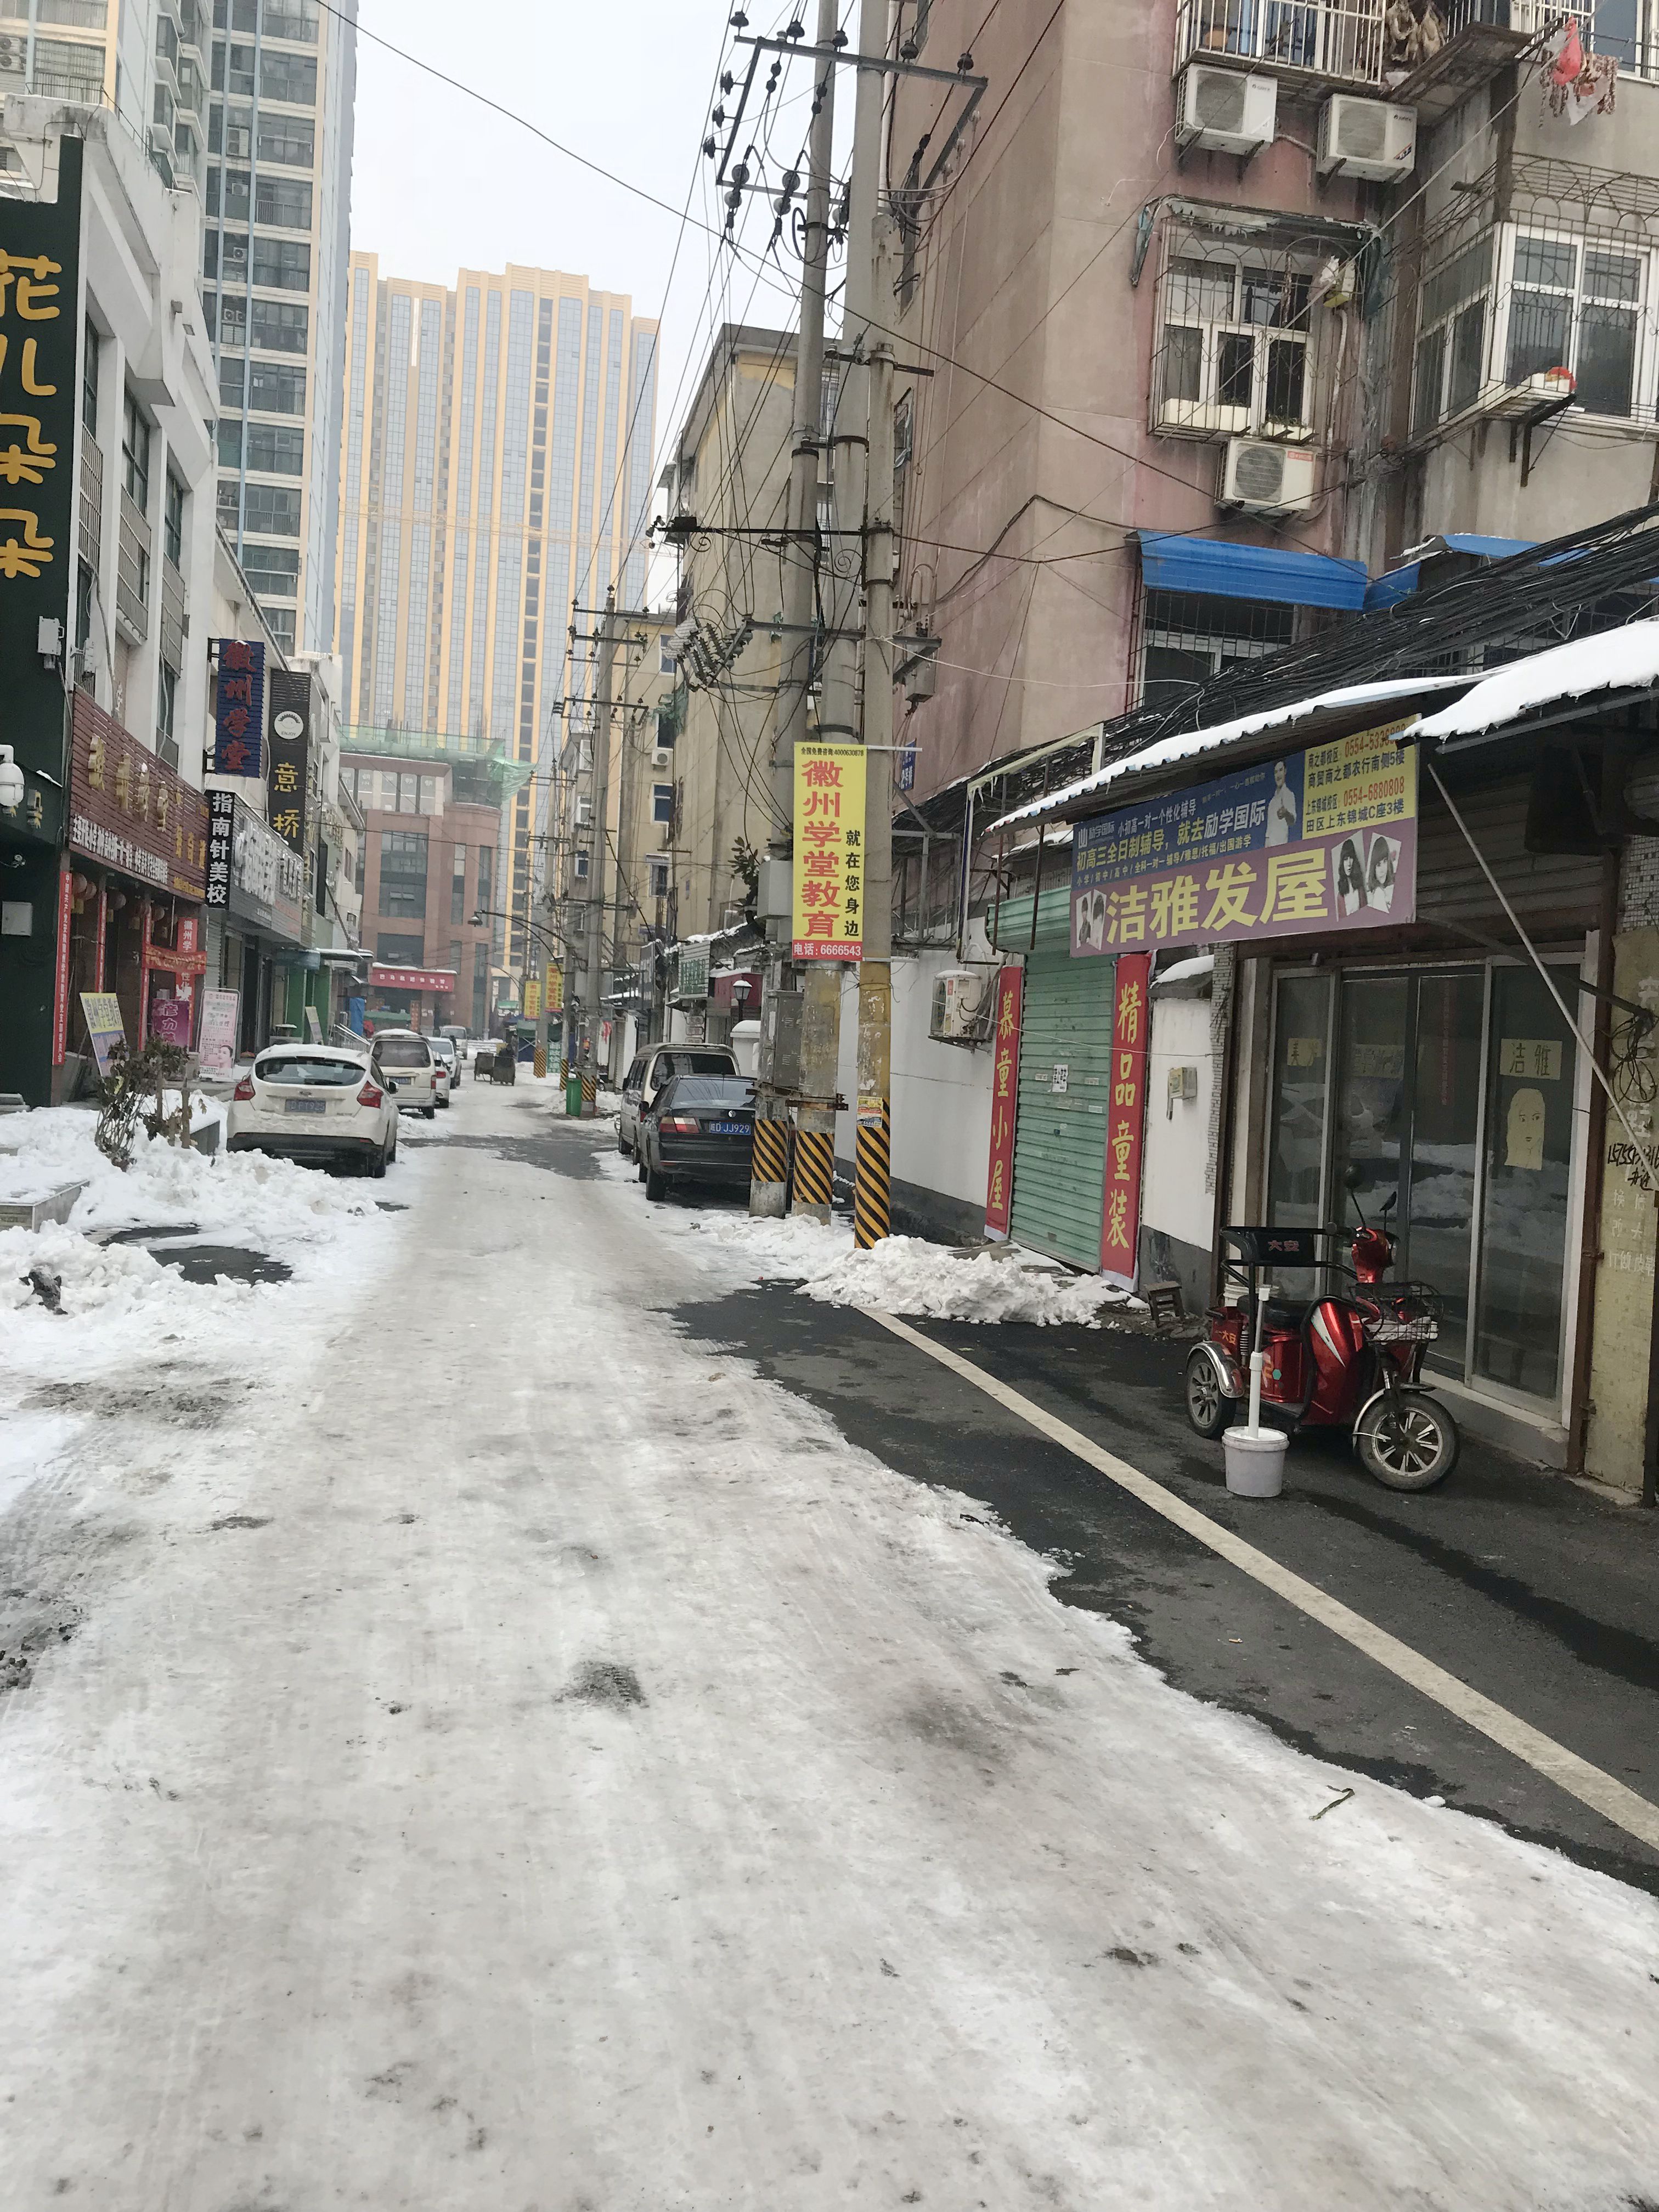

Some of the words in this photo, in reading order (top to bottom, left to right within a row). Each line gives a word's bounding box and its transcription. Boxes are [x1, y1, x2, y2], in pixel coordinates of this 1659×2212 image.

[222, 641, 256, 770] 徽州学堂
[273, 762, 301, 838] 意桥
[1344, 776, 1404, 806] 0554-6880808
[207, 792, 233, 904] 指南针美校
[801, 760, 844, 938] 徽州学堂教育
[844, 830, 861, 936] 就在您身边
[1106, 848, 1328, 944] 洁雅发屋
[1510, 1041, 1552, 1077] 洁雅
[1107, 981, 1142, 1249] 精品童装
[1267, 1240, 1300, 1252] 大安
